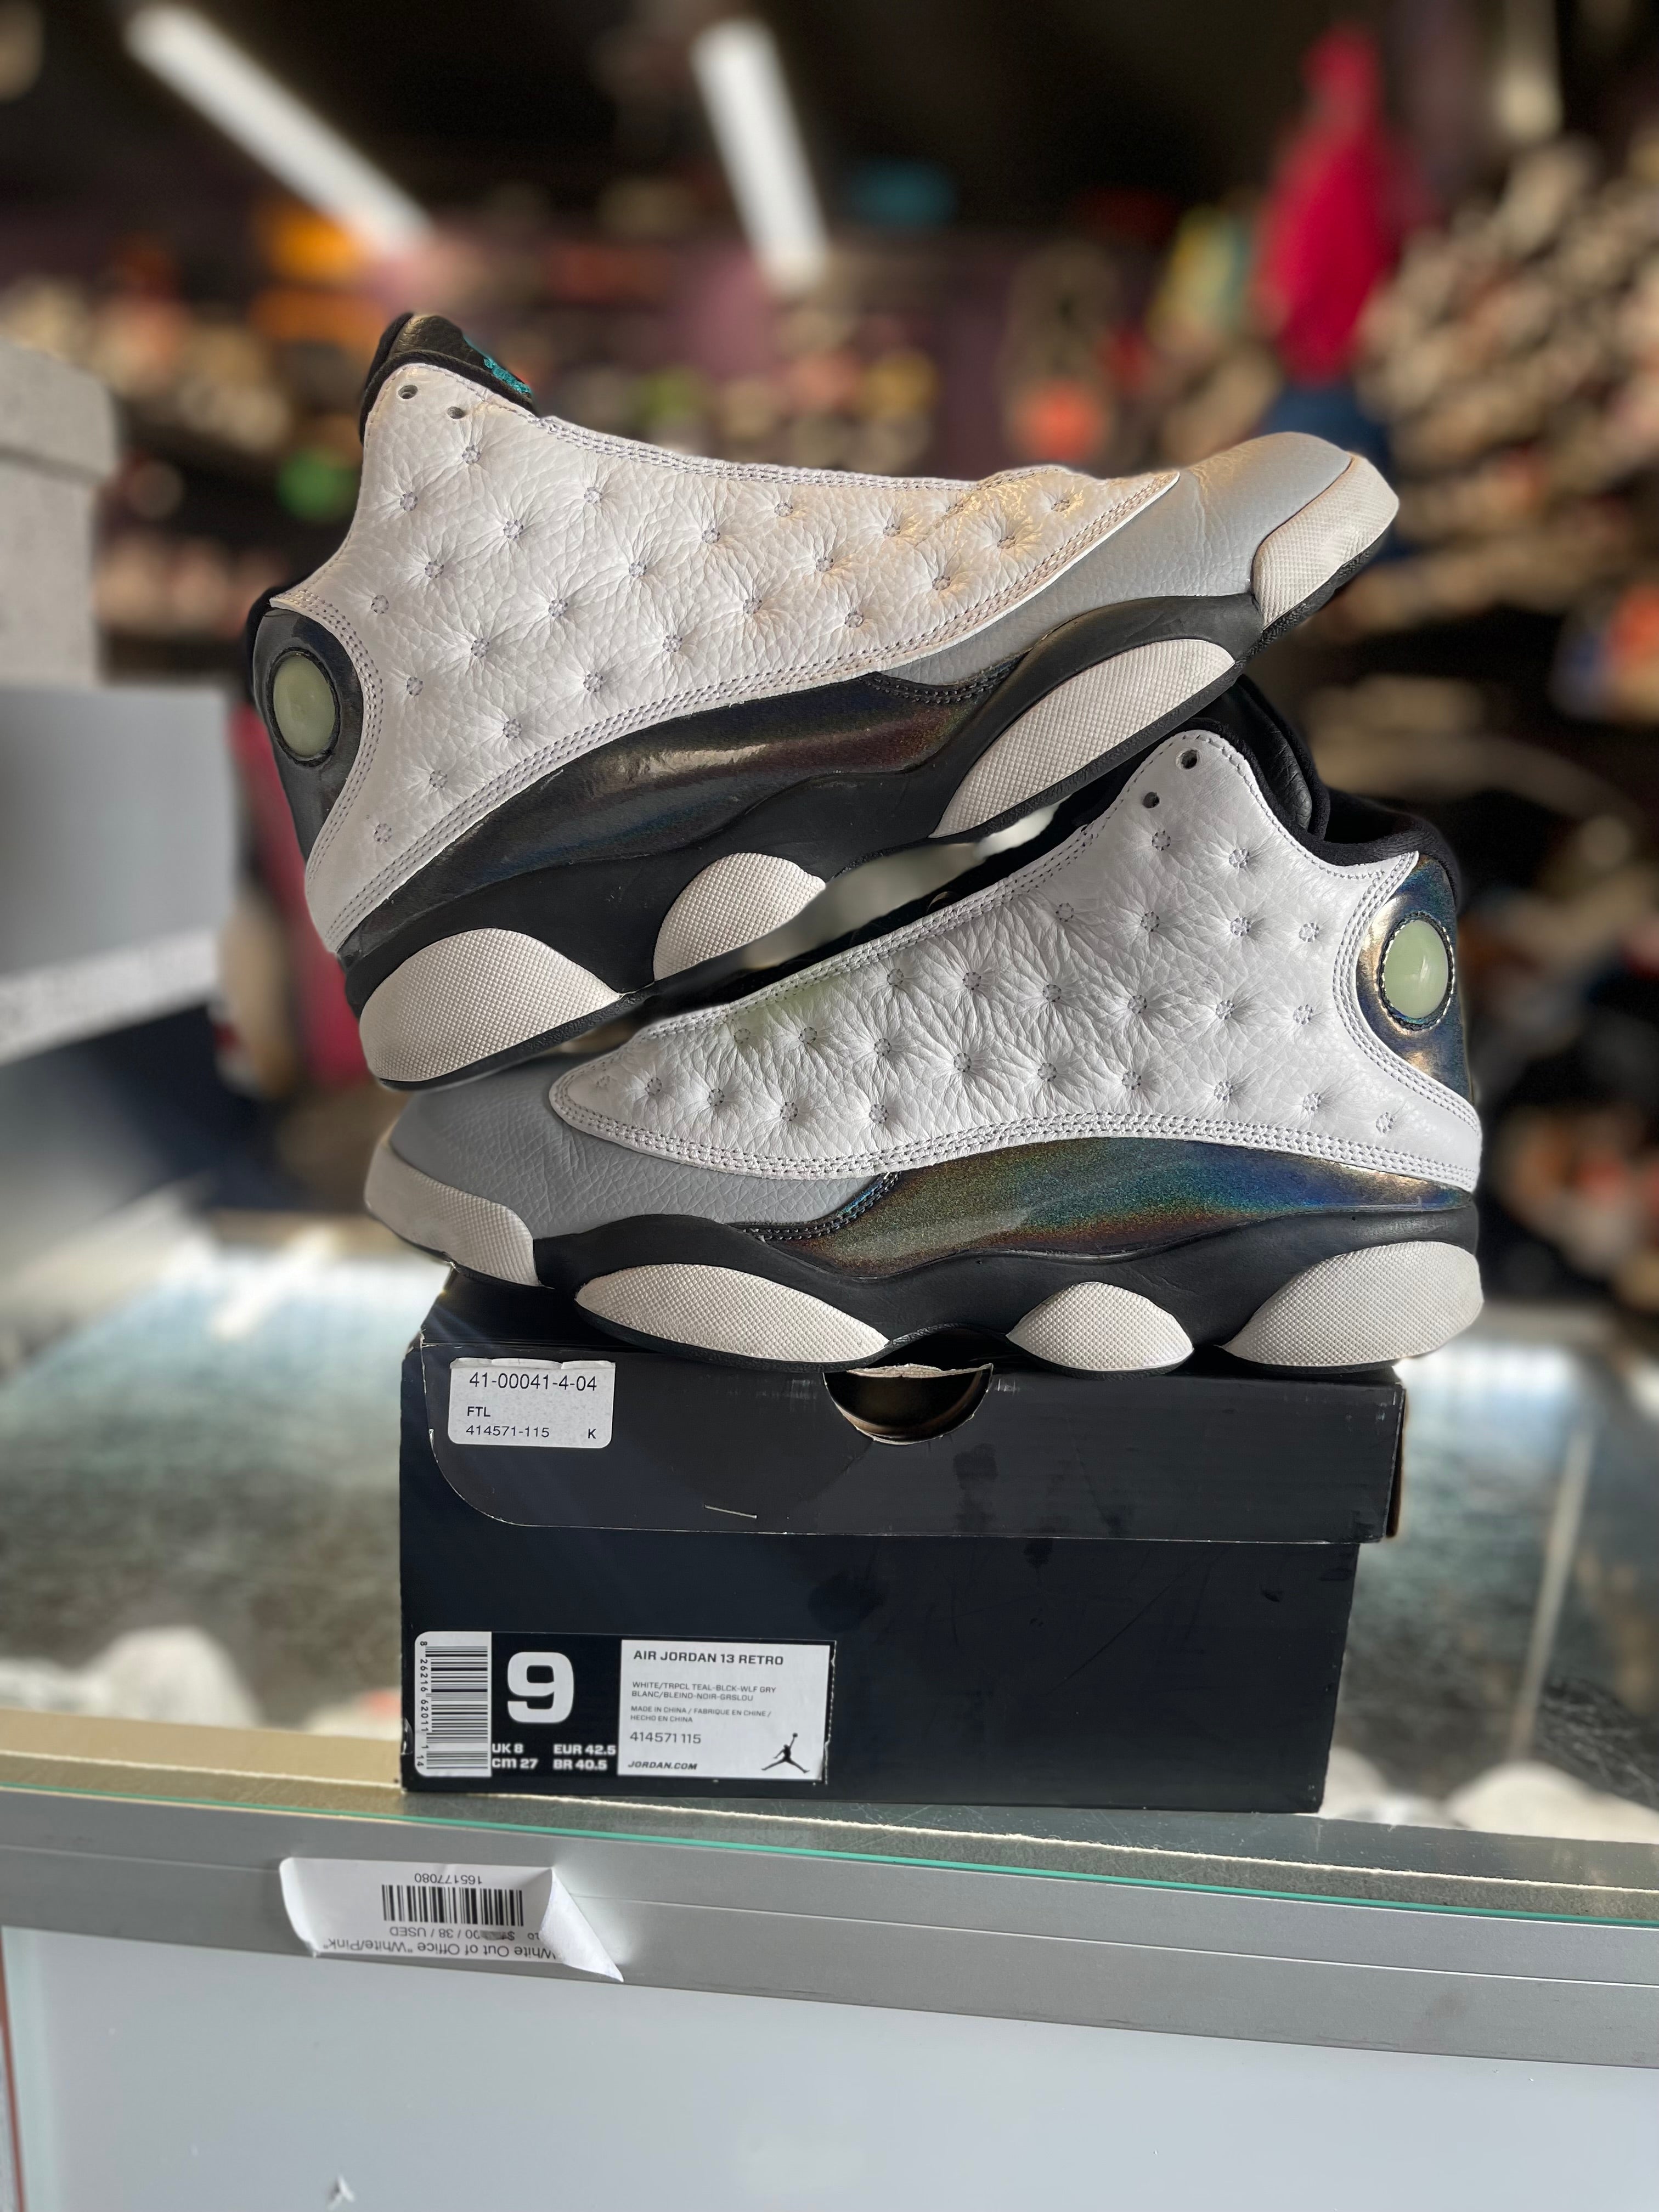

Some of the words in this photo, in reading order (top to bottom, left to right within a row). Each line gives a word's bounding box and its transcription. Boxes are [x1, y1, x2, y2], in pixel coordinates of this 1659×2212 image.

[469, 1372, 597, 1391] 41-00041-4-04
[467, 1406, 491, 1417] FTL
[466, 1425, 550, 1438] 414571-115
[588, 1429, 596, 1439] K
[633, 1650, 657, 1660] AIR
[660, 1651, 716, 1663] JORDAN
[720, 1654, 735, 1663] 13
[738, 1654, 783, 1665] RETRO
[420, 1658, 428, 1692] 26216
[507, 1652, 574, 1723] 9
[632, 1681, 690, 1690] WHITE/TRPCL
[692, 1683, 758, 1692] TEAL-BLCK-WLF
[631, 1690, 754, 1701] BLANC/BLEIND-NOIR-GRSLOU
[420, 1699, 429, 1732] 62011
[630, 1731, 677, 1743] 414571
[681, 1734, 702, 1744] 115
[492, 1743, 511, 1753] UK
[514, 1743, 523, 1753] 8
[553, 1743, 582, 1754] EUR
[585, 1744, 617, 1756] 42.5
[492, 1758, 517, 1768] cm
[520, 1758, 539, 1769] 27
[553, 1759, 573, 1770] BR
[575, 1759, 607, 1771] 40.5
[628, 1761, 698, 1770] JORDAN.COM
[414, 1873, 483, 1884] 165177080
[390, 1926, 426, 1937] USED
[438, 1928, 454, 1938] 38
[323, 1938, 413, 1954] "White/Pink"
[417, 1942, 460, 1955] Office
[465, 1944, 478, 1956] of
[483, 1944, 510, 1957] Out
